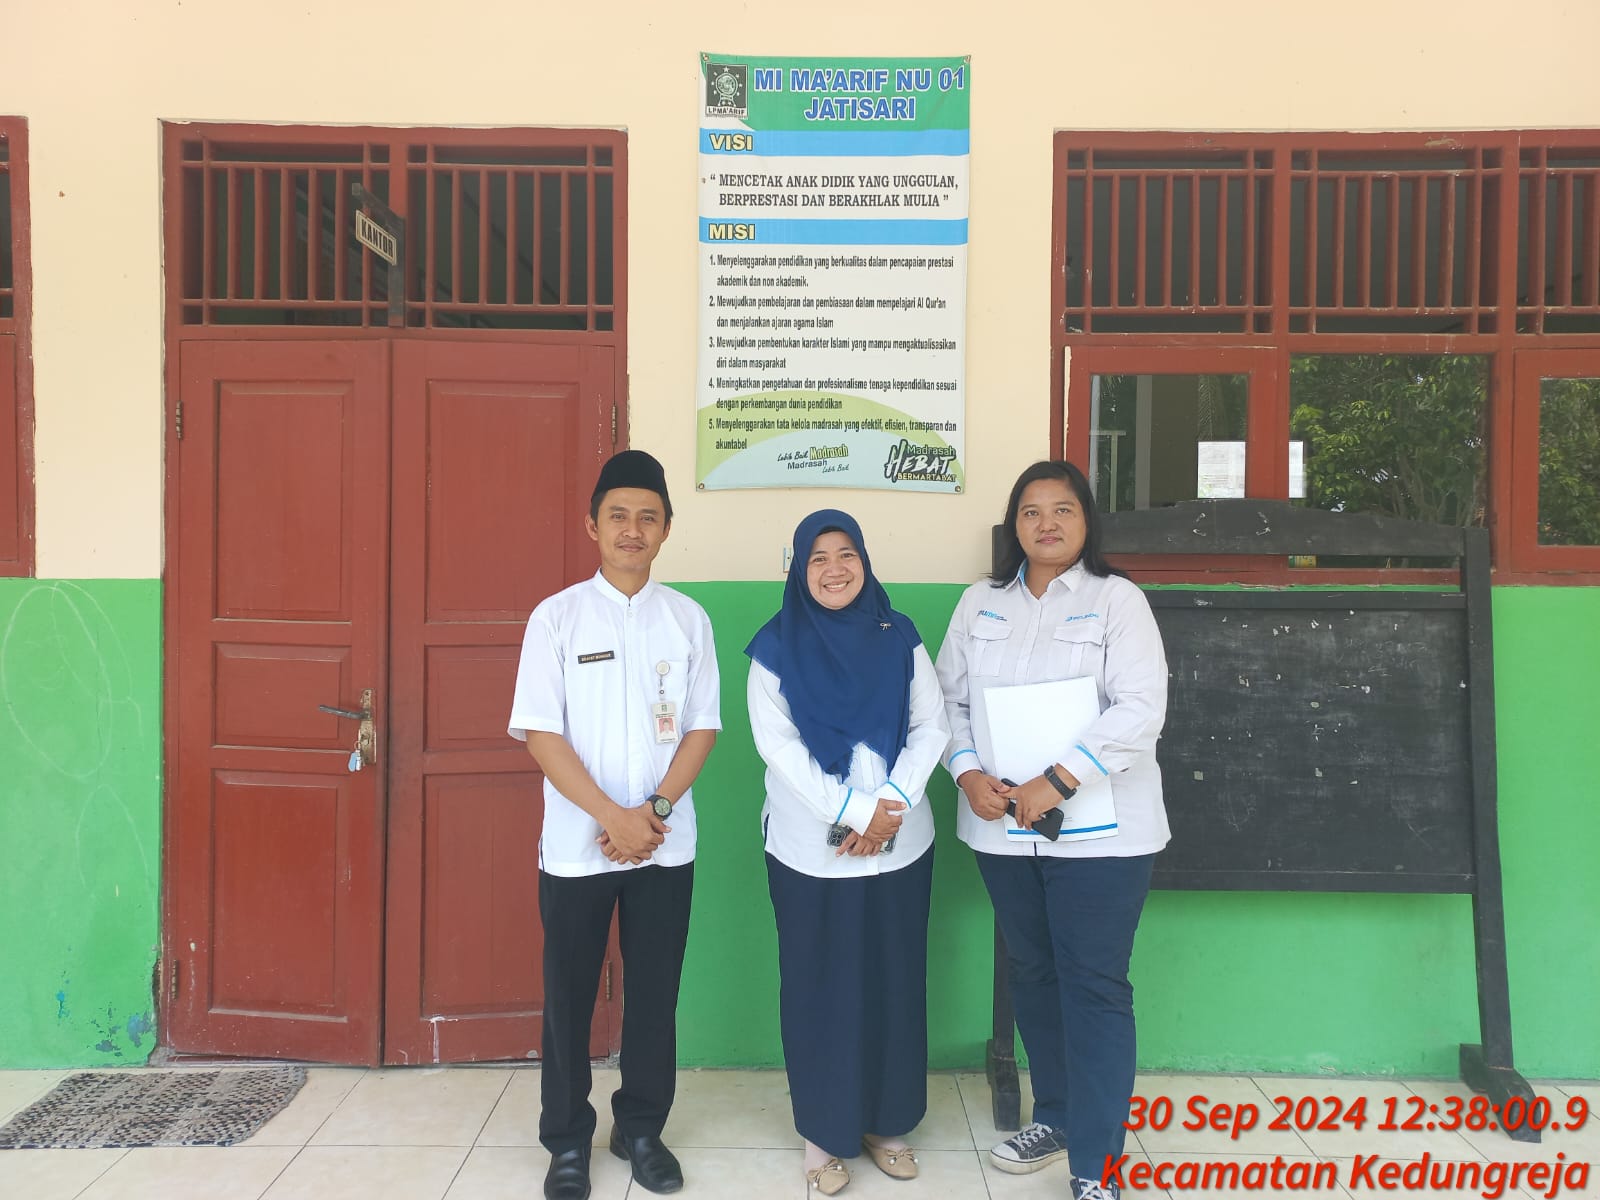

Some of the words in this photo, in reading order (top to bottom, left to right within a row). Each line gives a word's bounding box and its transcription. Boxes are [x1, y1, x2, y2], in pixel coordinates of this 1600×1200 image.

[755, 68, 782, 91] MI
[791, 69, 888, 93] MA'ARIF
[896, 69, 931, 91] NU
[938, 64, 965, 90] 01
[804, 97, 916, 120] JATISARI
[709, 134, 753, 151] VISI
[719, 174, 782, 188] MENCETAK
[786, 175, 819, 188] ANAK
[822, 175, 854, 188] DIDIK
[859, 175, 890, 188] YANG
[893, 175, 958, 190] UNGGULAN,
[719, 194, 798, 206] BERPRESTASI
[802, 195, 825, 206] DAN
[829, 195, 900, 206] BERAKHLAK
[903, 195, 940, 207] MULIA
[361, 218, 393, 258] KANTOR
[709, 223, 755, 240] MISI
[710, 254, 716, 265] 1.
[717, 254, 776, 268] Menyelenggarakan
[778, 255, 812, 268] pendidikan
[814, 257, 829, 269] yang
[831, 256, 867, 267] berkualitas
[869, 256, 888, 267] dalam
[889, 256, 926, 269] pencapaian
[928, 256, 953, 269] prestasi
[717, 275, 747, 286] akademik
[749, 276, 760, 286] dan
[763, 278, 774, 286] non
[776, 276, 808, 287] akademik.
[709, 296, 715, 307] 2.
[717, 296, 756, 309] Mewujudkan
[758, 296, 800, 309] pembelajaran
[803, 296, 814, 307] dan
[816, 297, 854, 308] pembiasaan
[856, 297, 874, 308] dalam
[877, 297, 915, 311] mempelajari
[917, 297, 923, 308] Al
[926, 297, 946, 308] Qur'an
[717, 317, 728, 327] dan
[730, 317, 770, 330] menjalankan
[772, 317, 791, 330] ajaran
[794, 319, 814, 330] agama
[817, 317, 833, 328] Islam
[709, 337, 715, 348] 3.
[717, 337, 756, 350] Mewujudkan
[758, 337, 800, 350] pembentukan
[802, 337, 829, 348] karakter
[831, 337, 850, 348] Islami
[851, 340, 866, 351] yang
[868, 340, 891, 351] mampu
[893, 338, 956, 351] mengaktualisasikan
[717, 357, 727, 368] diri
[729, 357, 747, 368] dalam
[749, 357, 786, 371] masyarakat
[709, 378, 715, 389] 4.
[717, 377, 760, 390] Meningkatkan
[762, 378, 802, 391] pengetahuan
[804, 378, 816, 388] dan
[817, 378, 867, 389] profesionalisme
[869, 380, 891, 392] tenaga
[893, 379, 934, 392] kependidikan
[936, 380, 956, 391] sesuai
[716, 398, 739, 411] dengan
[741, 398, 788, 411] perkembangan
[789, 399, 806, 409] dunia
[808, 398, 842, 411] pendidikan
[709, 419, 715, 429] 5.
[716, 418, 775, 432] Menyelenggarakan
[777, 419, 789, 429] tata
[791, 419, 810, 429] kelola
[812, 419, 842, 429] madrasah
[844, 421, 860, 432] yang
[861, 419, 883, 432] efektif,
[885, 419, 908, 432] efisien,
[909, 421, 943, 432] transparan
[945, 421, 956, 431] dan
[716, 438, 747, 449] akuntabel
[907, 445, 956, 456] Madrasah
[810, 444, 848, 460] Madrasah
[787, 460, 827, 470] Madrasah
